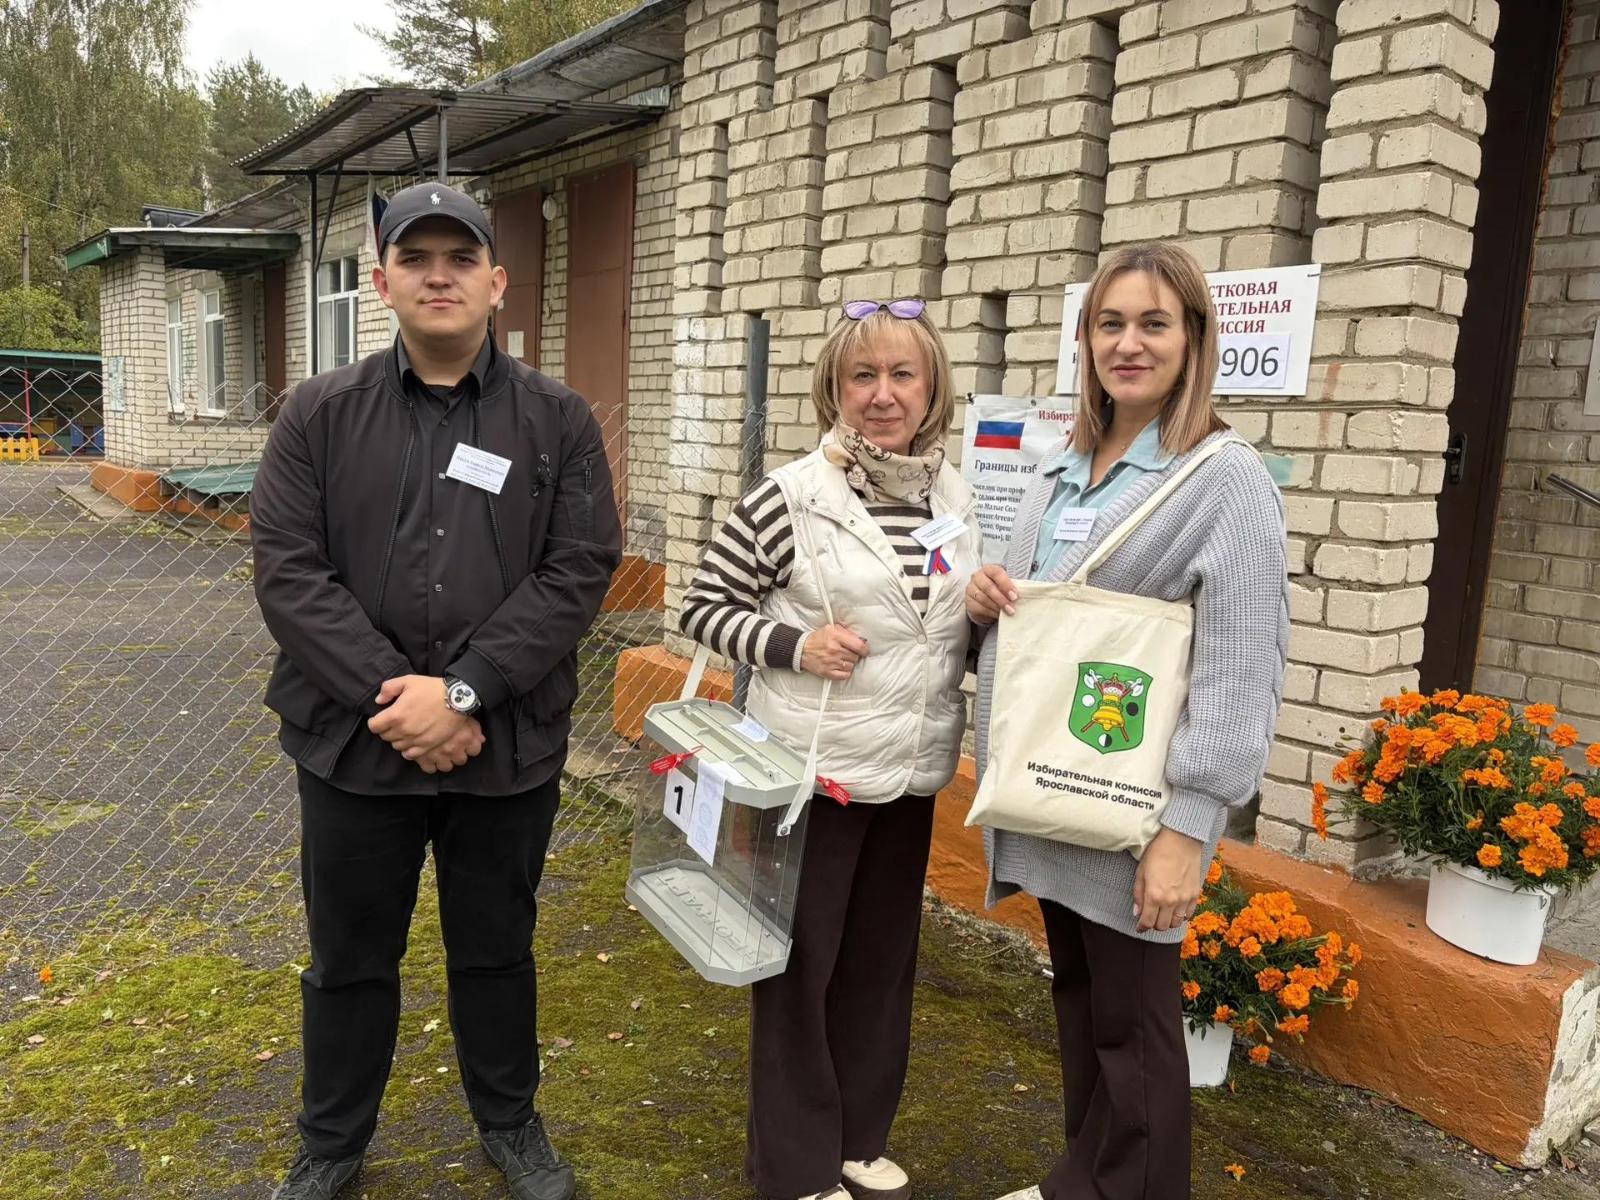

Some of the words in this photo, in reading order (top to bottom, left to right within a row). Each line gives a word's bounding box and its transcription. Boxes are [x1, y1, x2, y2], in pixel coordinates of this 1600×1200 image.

[1209, 281, 1278, 298] СТКОВАЯ
[1218, 319, 1266, 334] ИССИЯ
[1220, 346, 1280, 377] 906
[1038, 410, 1076, 424] Избира
[974, 459, 1019, 473] Границы
[1020, 463, 1038, 474] изб
[1026, 761, 1113, 788] Избирательная
[1115, 781, 1163, 800] комиссия
[673, 785, 684, 815] 1
[1035, 776, 1110, 801] Ярославской
[1111, 794, 1155, 811] области
